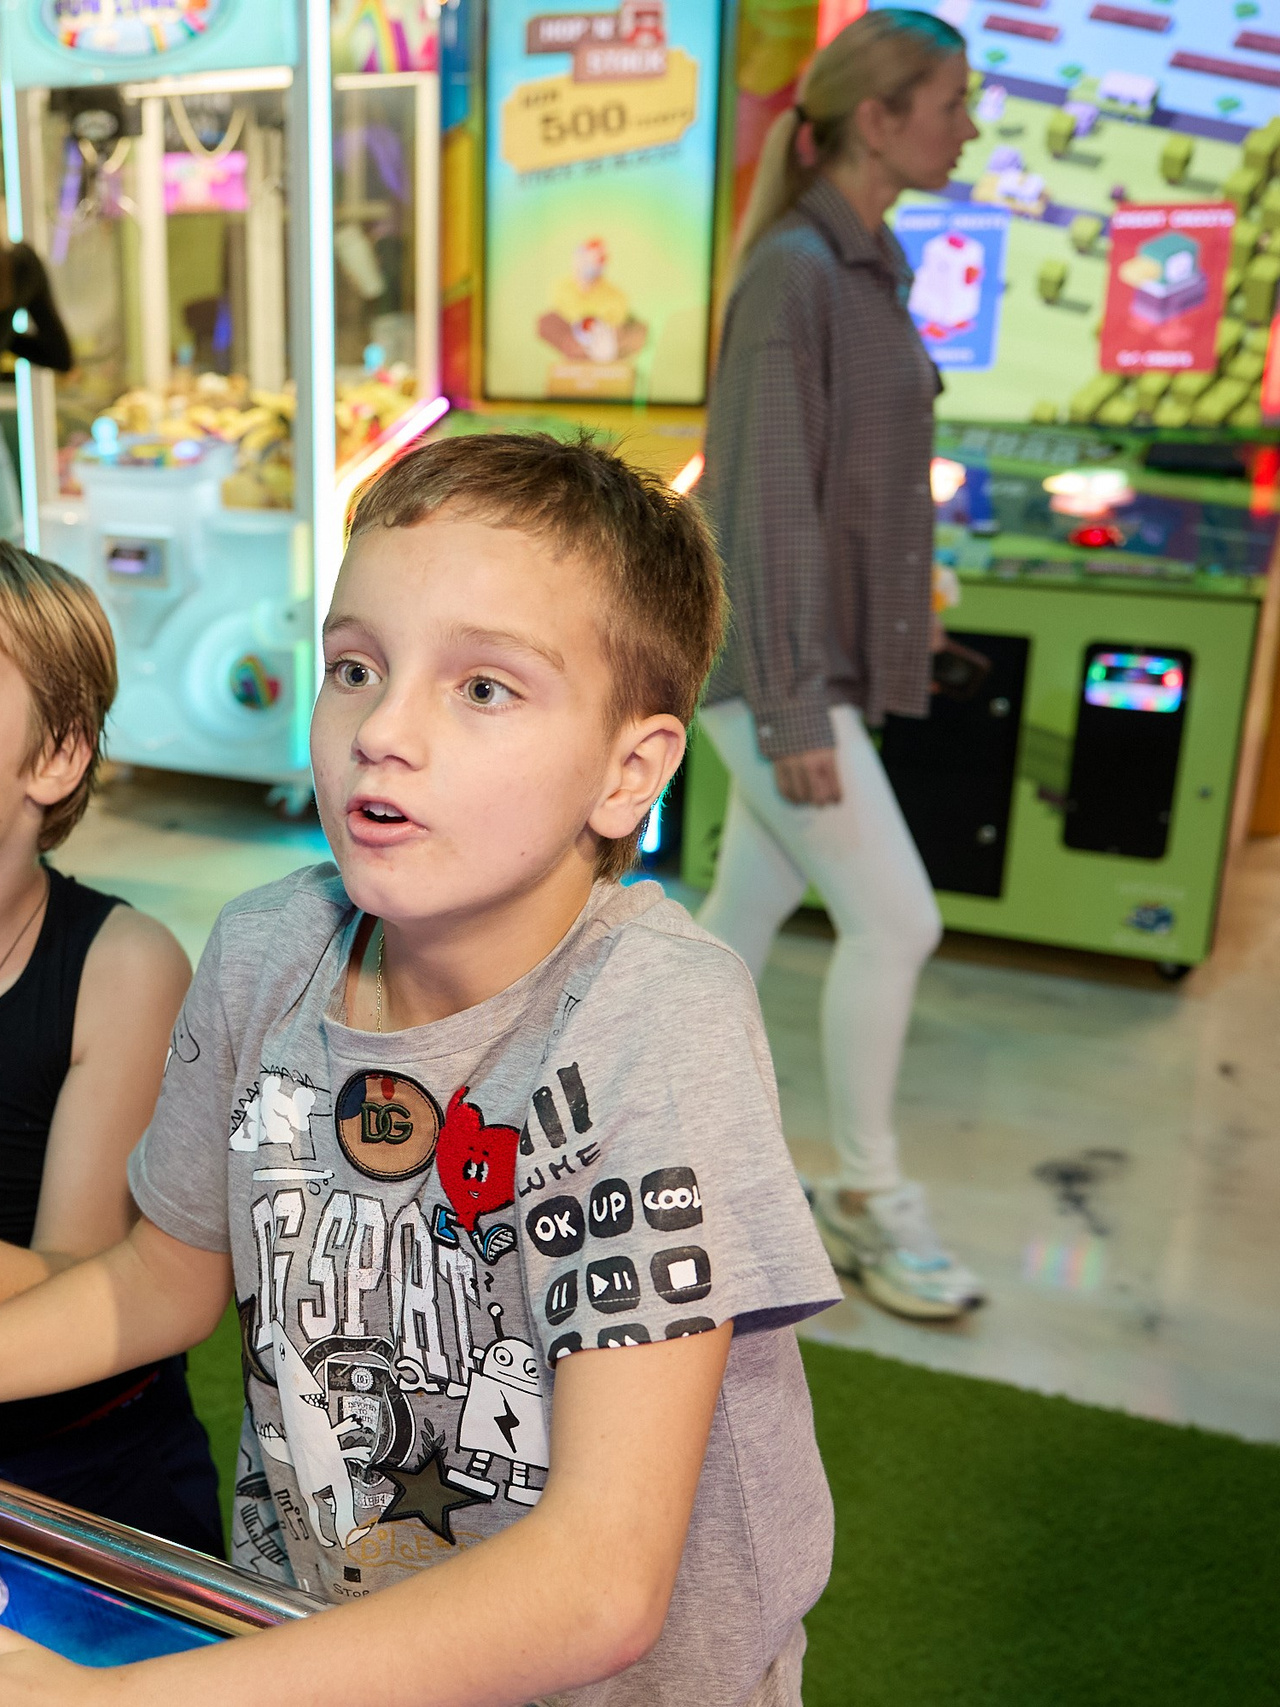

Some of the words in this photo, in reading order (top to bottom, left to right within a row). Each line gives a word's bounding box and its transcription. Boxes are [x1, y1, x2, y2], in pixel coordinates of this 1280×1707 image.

[542, 103, 626, 147] 500
[361, 1101, 414, 1145] DG
[535, 1210, 577, 1242] OK
[592, 1191, 626, 1223] UP
[643, 1185, 702, 1211] COOL
[333, 1583, 370, 1598] STOP
